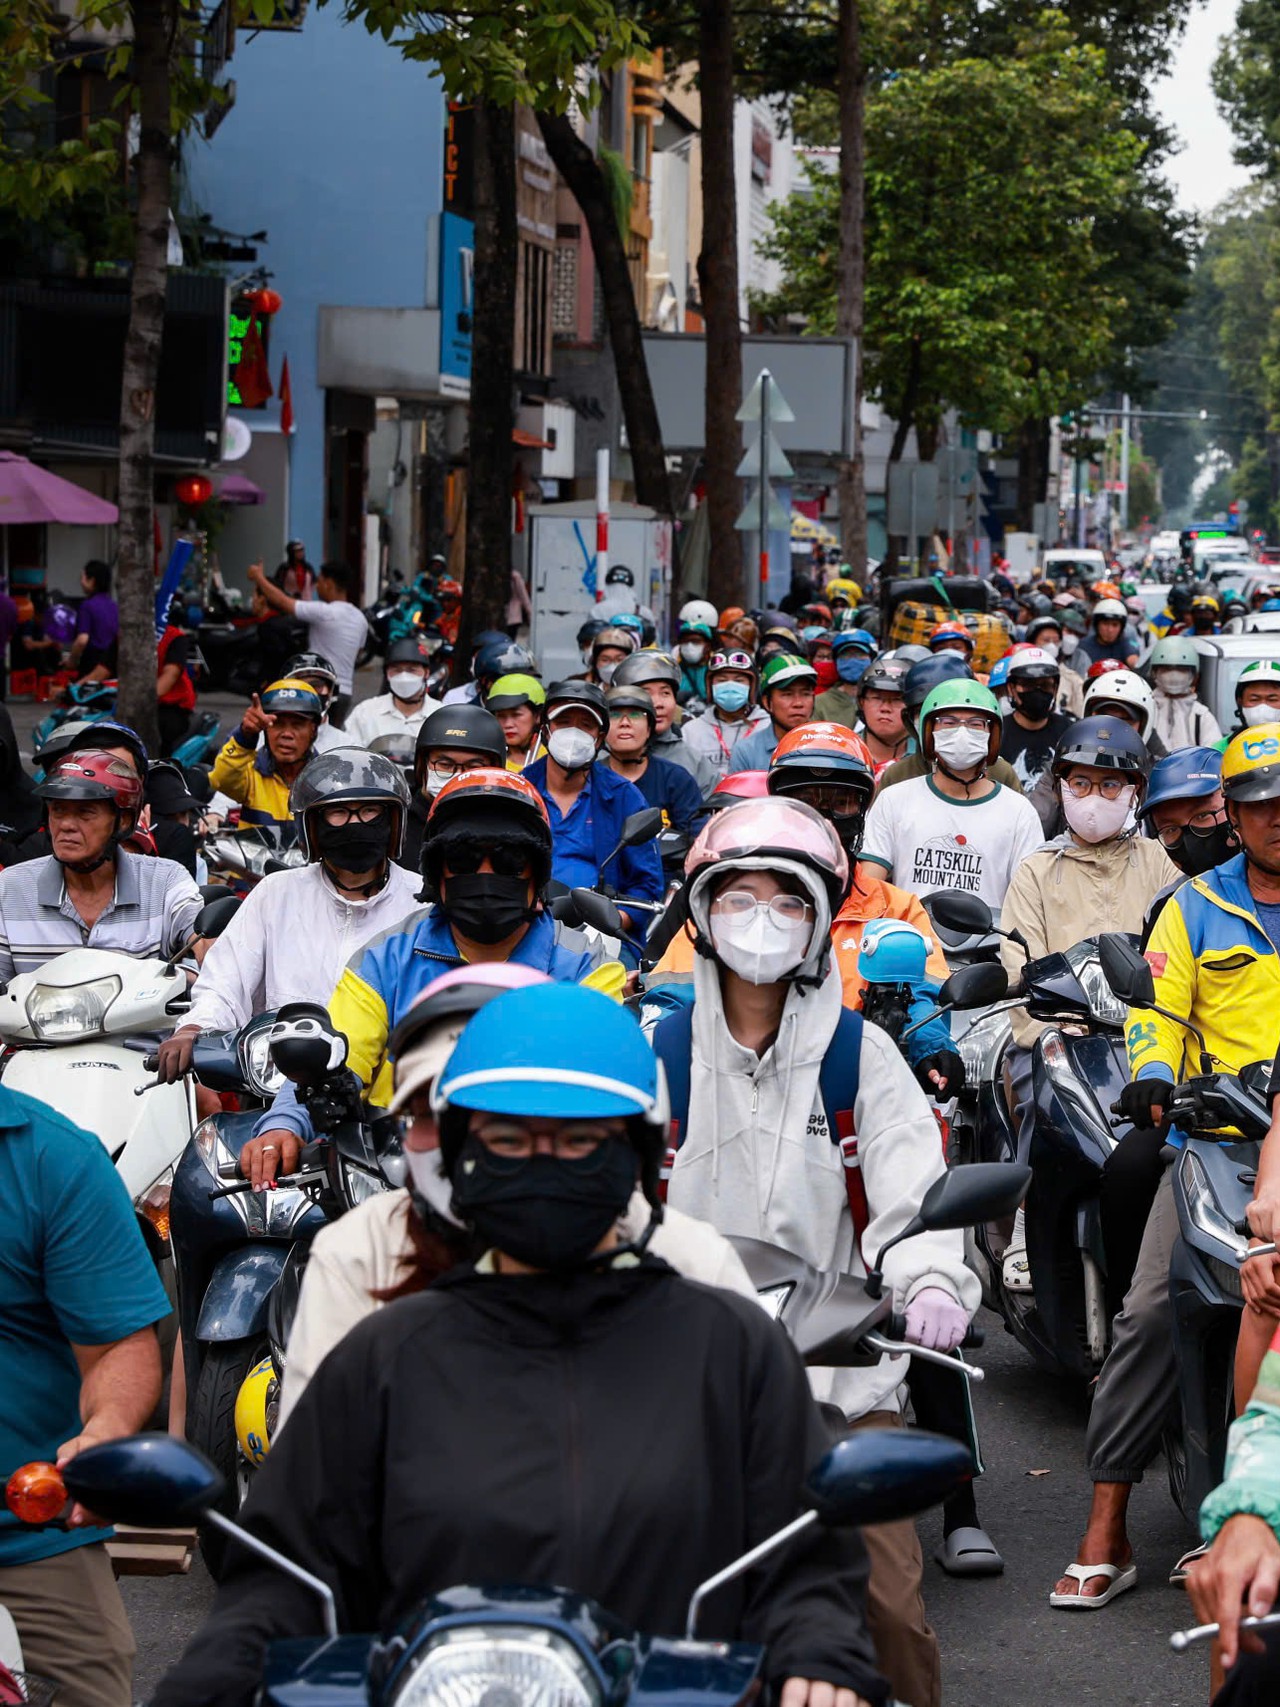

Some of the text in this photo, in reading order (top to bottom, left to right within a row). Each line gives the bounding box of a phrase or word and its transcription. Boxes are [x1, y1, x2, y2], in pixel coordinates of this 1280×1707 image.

[800, 733, 843, 743] Ahamove
[1242, 738, 1280, 760] be
[914, 847, 982, 875] CATSKILL
[912, 868, 981, 892] MOUNTAINS
[809, 1114, 826, 1126] ay
[806, 1125, 828, 1137] ove
